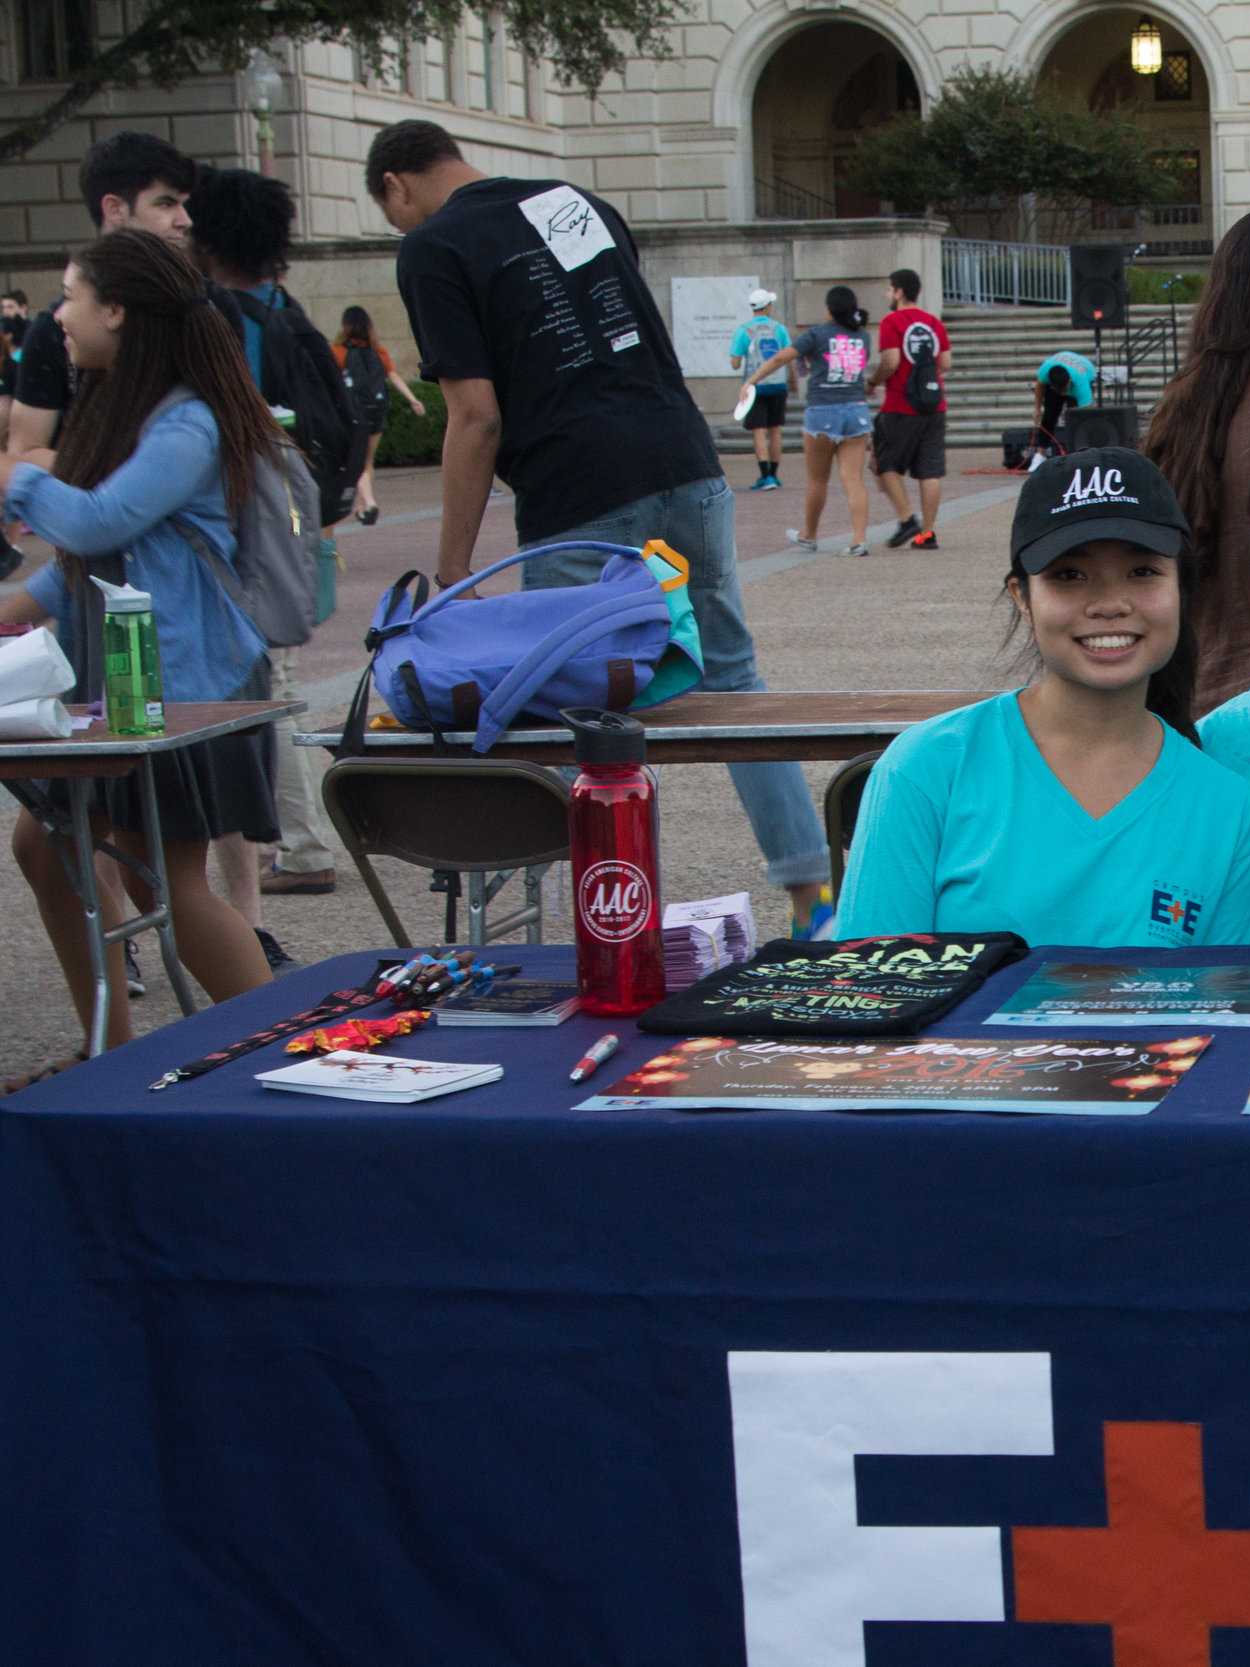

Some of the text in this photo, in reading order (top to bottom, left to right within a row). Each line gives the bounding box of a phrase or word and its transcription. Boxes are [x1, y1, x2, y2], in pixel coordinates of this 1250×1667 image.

[548, 201, 594, 241] Ray
[829, 338, 864, 354] DEEP
[1062, 466, 1125, 503] AAC
[590, 882, 640, 915] AAC
[1151, 889, 1202, 937] E+E
[885, 1043, 998, 1056] New
[1013, 1043, 1136, 1057] Year
